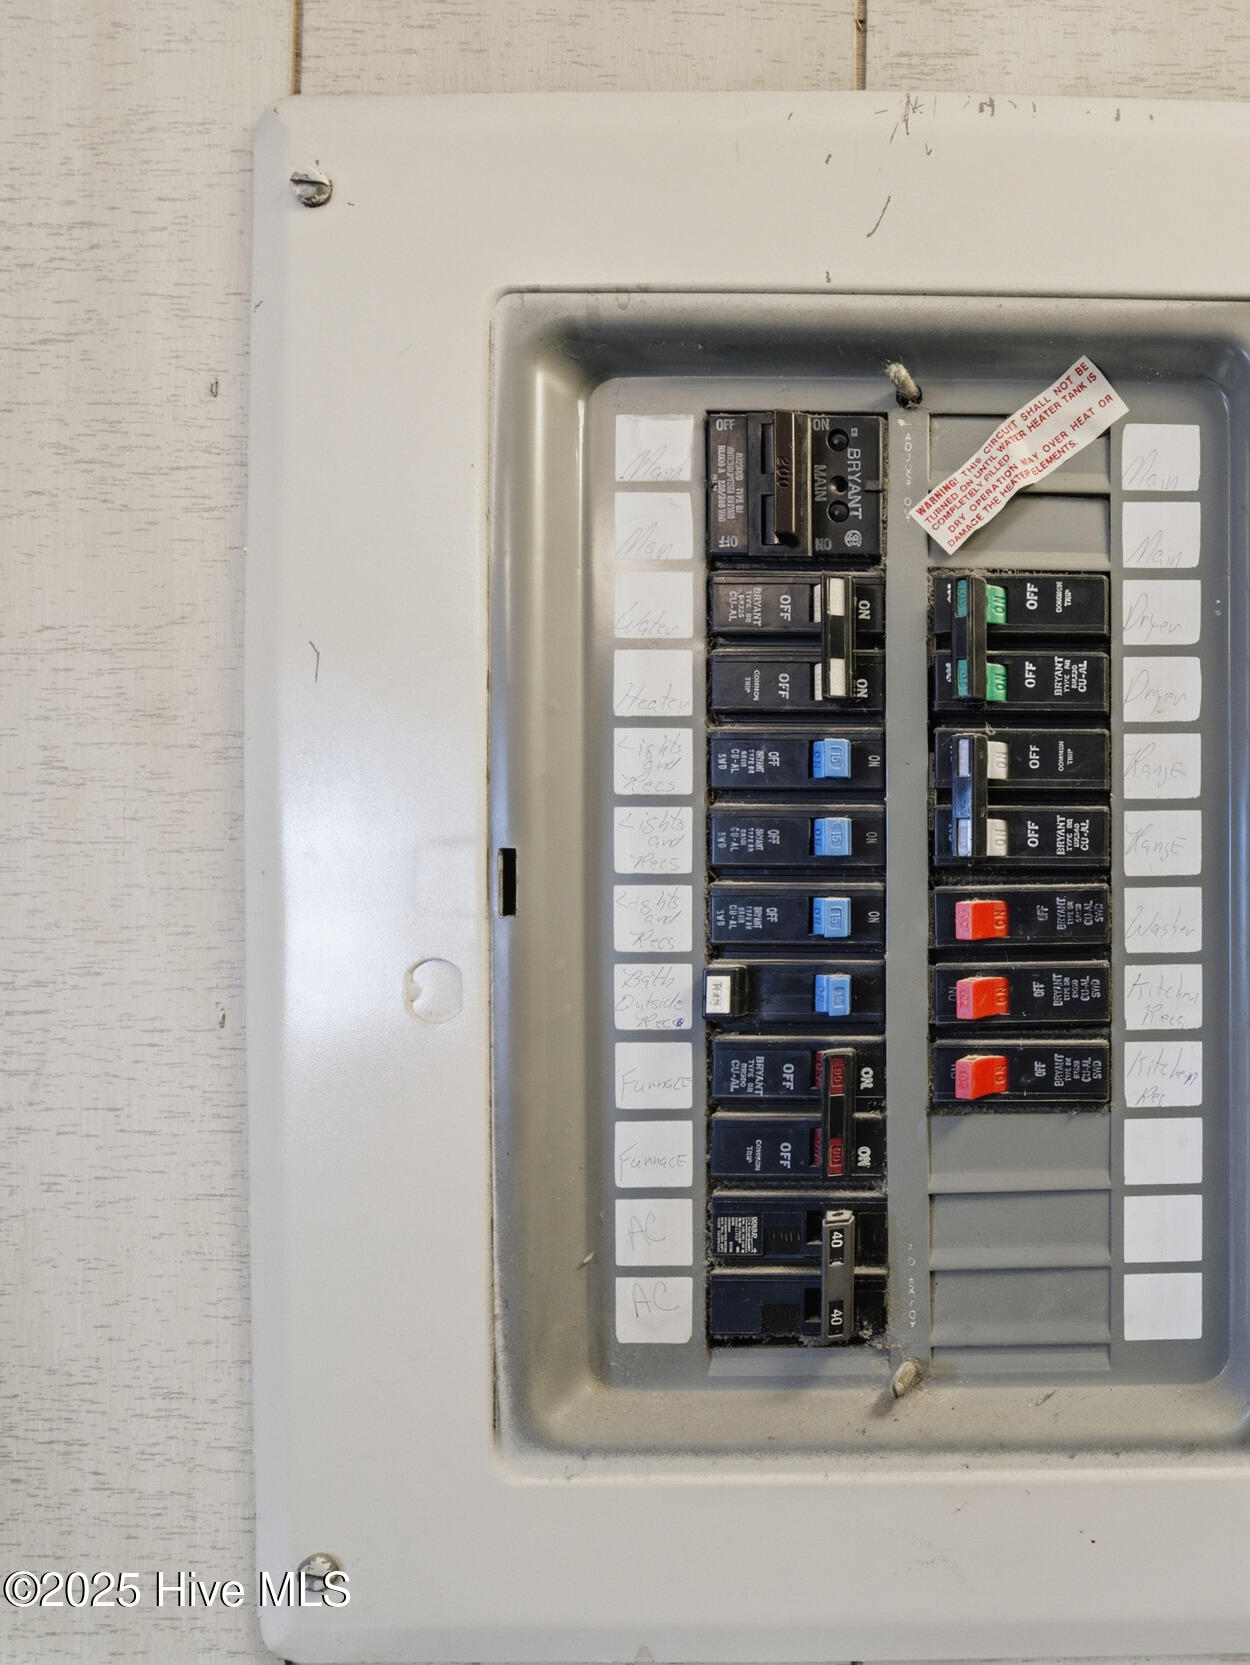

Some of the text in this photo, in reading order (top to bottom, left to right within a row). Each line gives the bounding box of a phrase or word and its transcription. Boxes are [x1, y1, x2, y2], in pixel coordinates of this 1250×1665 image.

[716, 419, 735, 430] OFF
[813, 419, 829, 430] ON
[916, 361, 1089, 517] WARNING! THIS CIRCUIT SHALL NOT BE
[925, 372, 1097, 524] TURNED ON UNTIL WATER HEATER TANK IS
[948, 512, 966, 533] DRY
[969, 462, 1019, 512] OPERATION
[1042, 430, 1068, 452] OVER
[1070, 407, 1095, 430] HEAT
[1098, 394, 1114, 408] OR
[814, 464, 826, 502] MAIN
[848, 448, 862, 519] BRYANT
[947, 440, 1079, 548] DAMAGE THE HEATER ELEMENTS.
[932, 481, 983, 531] COMPLETELY
[780, 595, 791, 621] OFF
[1026, 582, 1038, 610] OFF
[858, 600, 870, 620] ON
[777, 673, 789, 699] OFF
[1025, 661, 1036, 688] OFF
[1055, 656, 1063, 696] BRYANT
[856, 679, 867, 698] ON
[768, 752, 780, 766] OFF
[869, 755, 880, 767] ON
[1029, 744, 1040, 768] OFF
[1056, 815, 1066, 855] BRYANT
[755, 1056, 764, 1096] BRYANT
[783, 1063, 794, 1089] OFF
[1034, 1061, 1046, 1077] OFF
[1055, 1054, 1064, 1086] BRYANT
[780, 1143, 791, 1168] OFF
[628, 1213, 667, 1250] AC
[831, 1231, 842, 1247] 40
[633, 1282, 679, 1318] AC
[831, 1310, 842, 1325] 40
